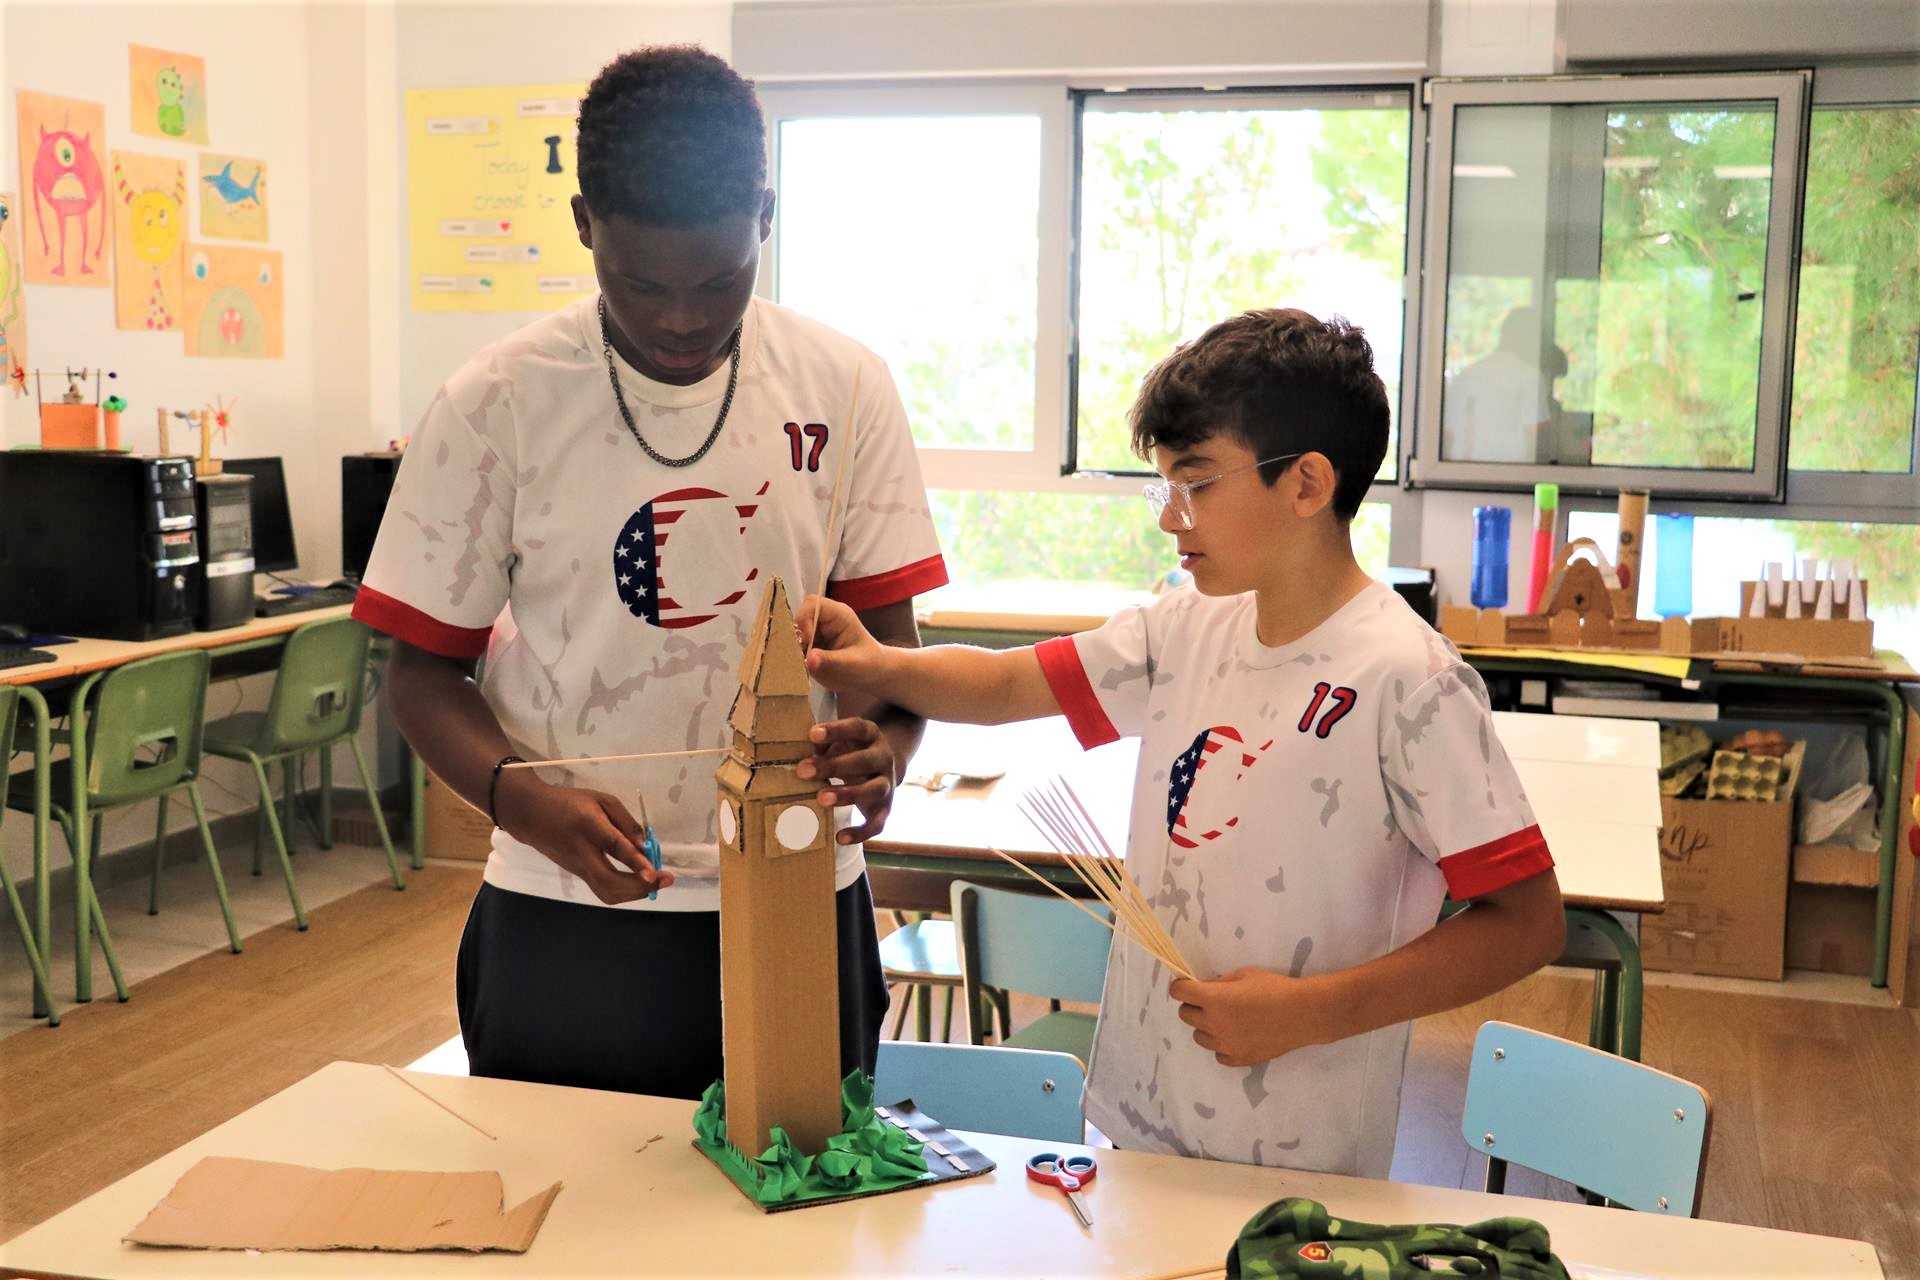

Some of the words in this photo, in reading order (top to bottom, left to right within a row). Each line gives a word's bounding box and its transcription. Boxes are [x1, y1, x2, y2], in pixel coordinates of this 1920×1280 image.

[783, 421, 829, 473] 17
[1297, 681, 1358, 740] 17
[1308, 1247, 1325, 1257] 5
